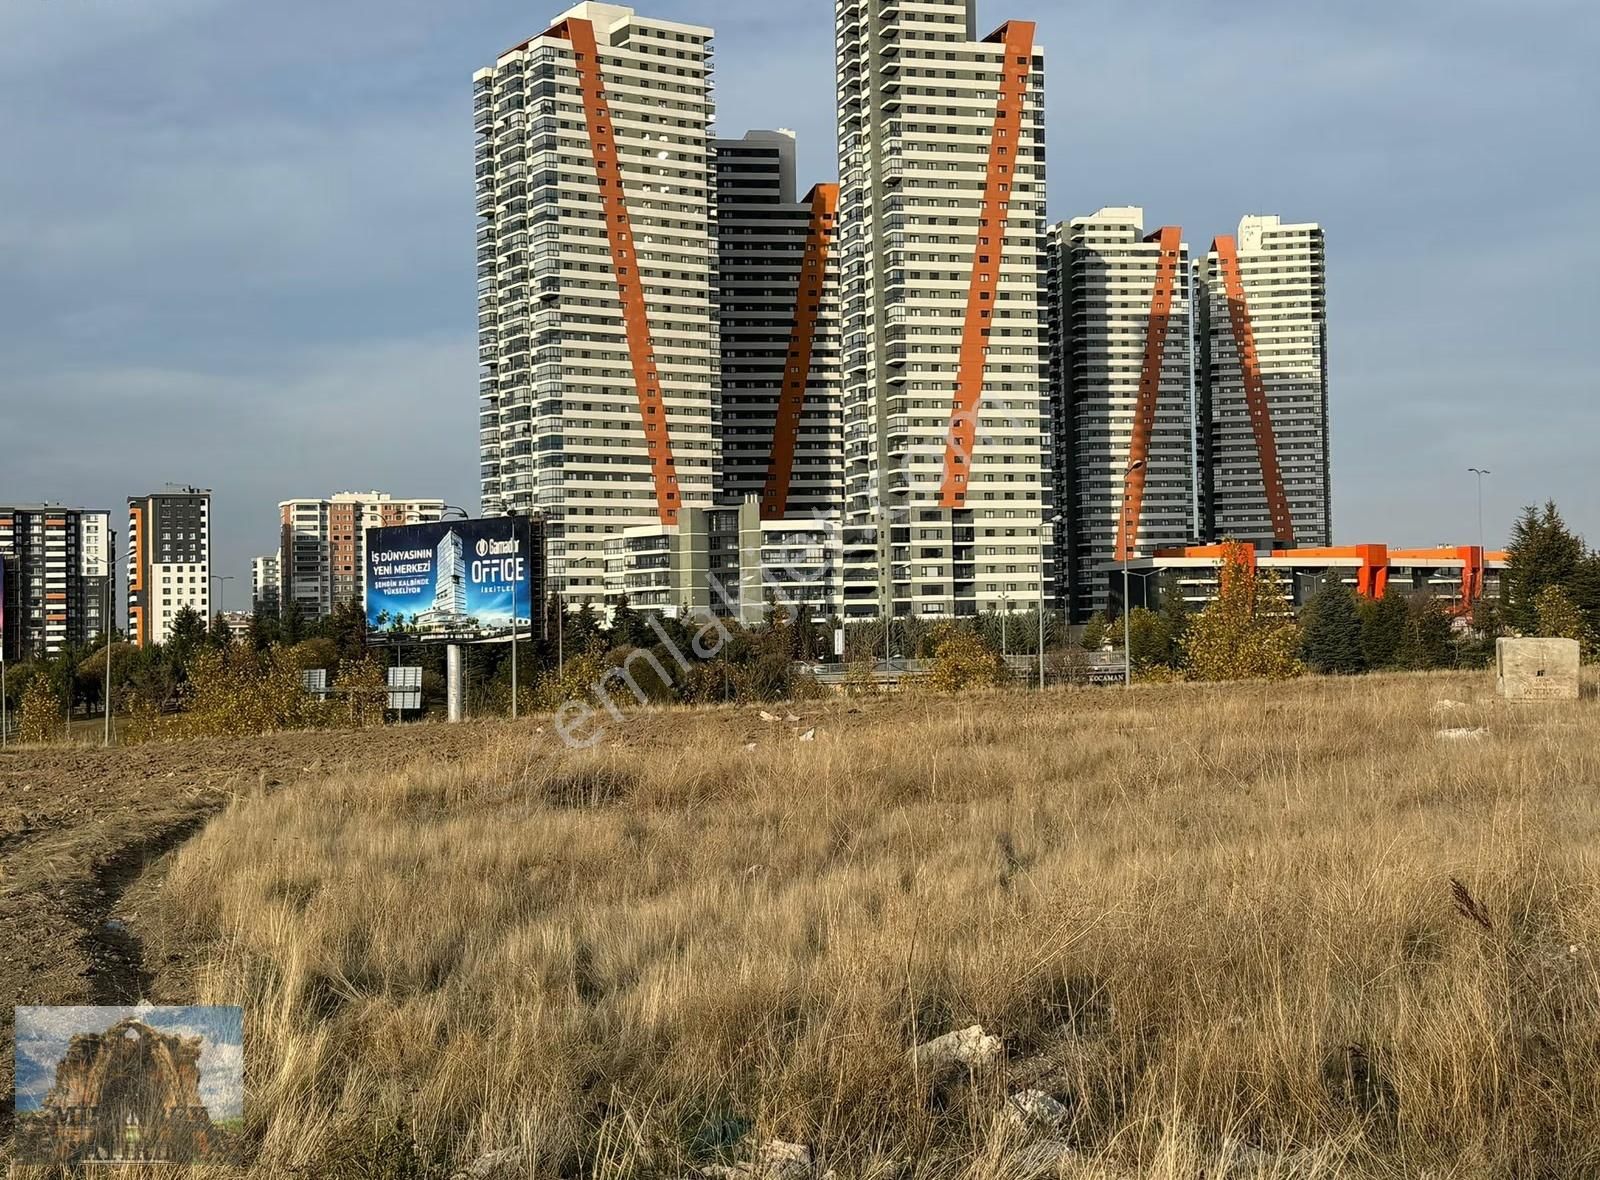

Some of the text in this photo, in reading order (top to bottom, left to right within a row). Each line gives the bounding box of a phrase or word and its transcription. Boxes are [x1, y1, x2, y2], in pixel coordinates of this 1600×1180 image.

[371, 549, 432, 565] İŞ DÜNYASININ
[373, 560, 431, 576] YENİ MERKEZİ
[472, 557, 525, 583] OFFICE
[1088, 674, 1125, 682] KOCAMAN
